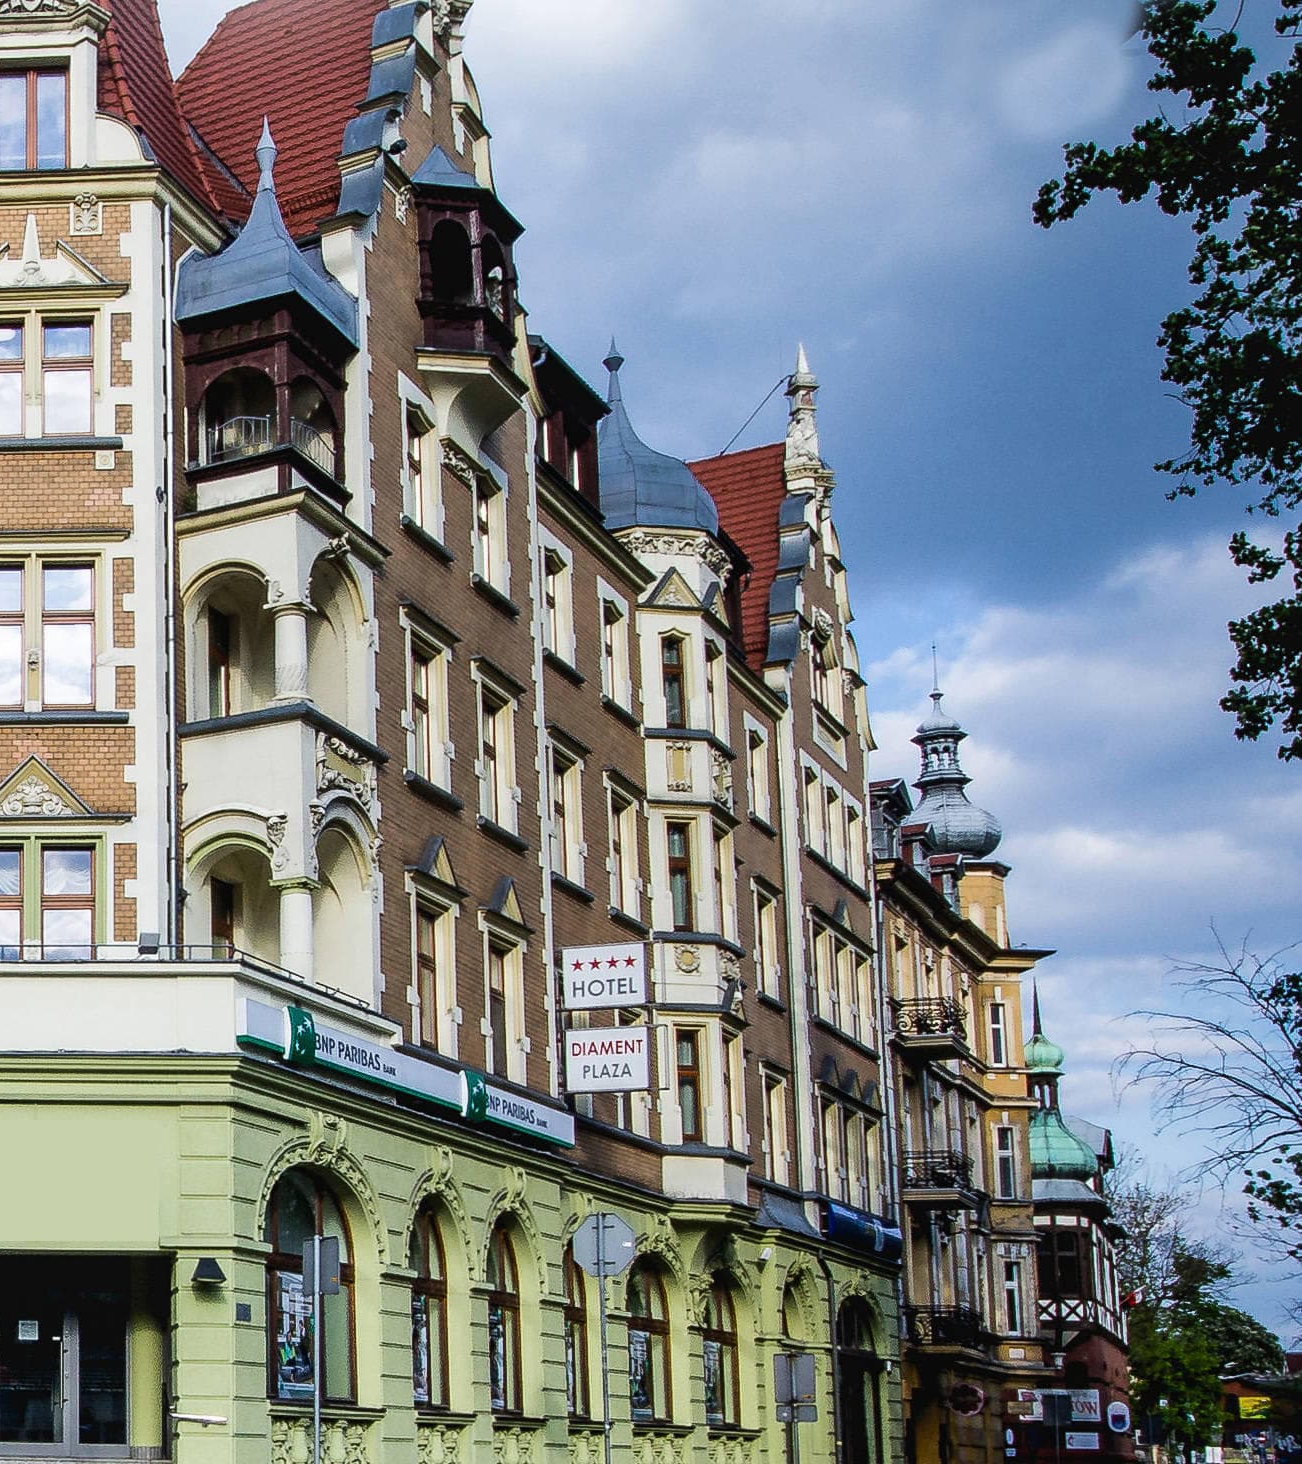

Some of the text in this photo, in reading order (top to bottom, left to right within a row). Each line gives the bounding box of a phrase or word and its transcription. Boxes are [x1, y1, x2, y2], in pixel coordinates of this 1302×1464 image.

[572, 977, 638, 998] HOTEL
[315, 1033, 336, 1055] BNP
[338, 1041, 381, 1071] PARIBAS
[571, 1039, 643, 1057] DIAMENT
[582, 1063, 632, 1079] PLAZA
[502, 1099, 536, 1124] PARIBAS
